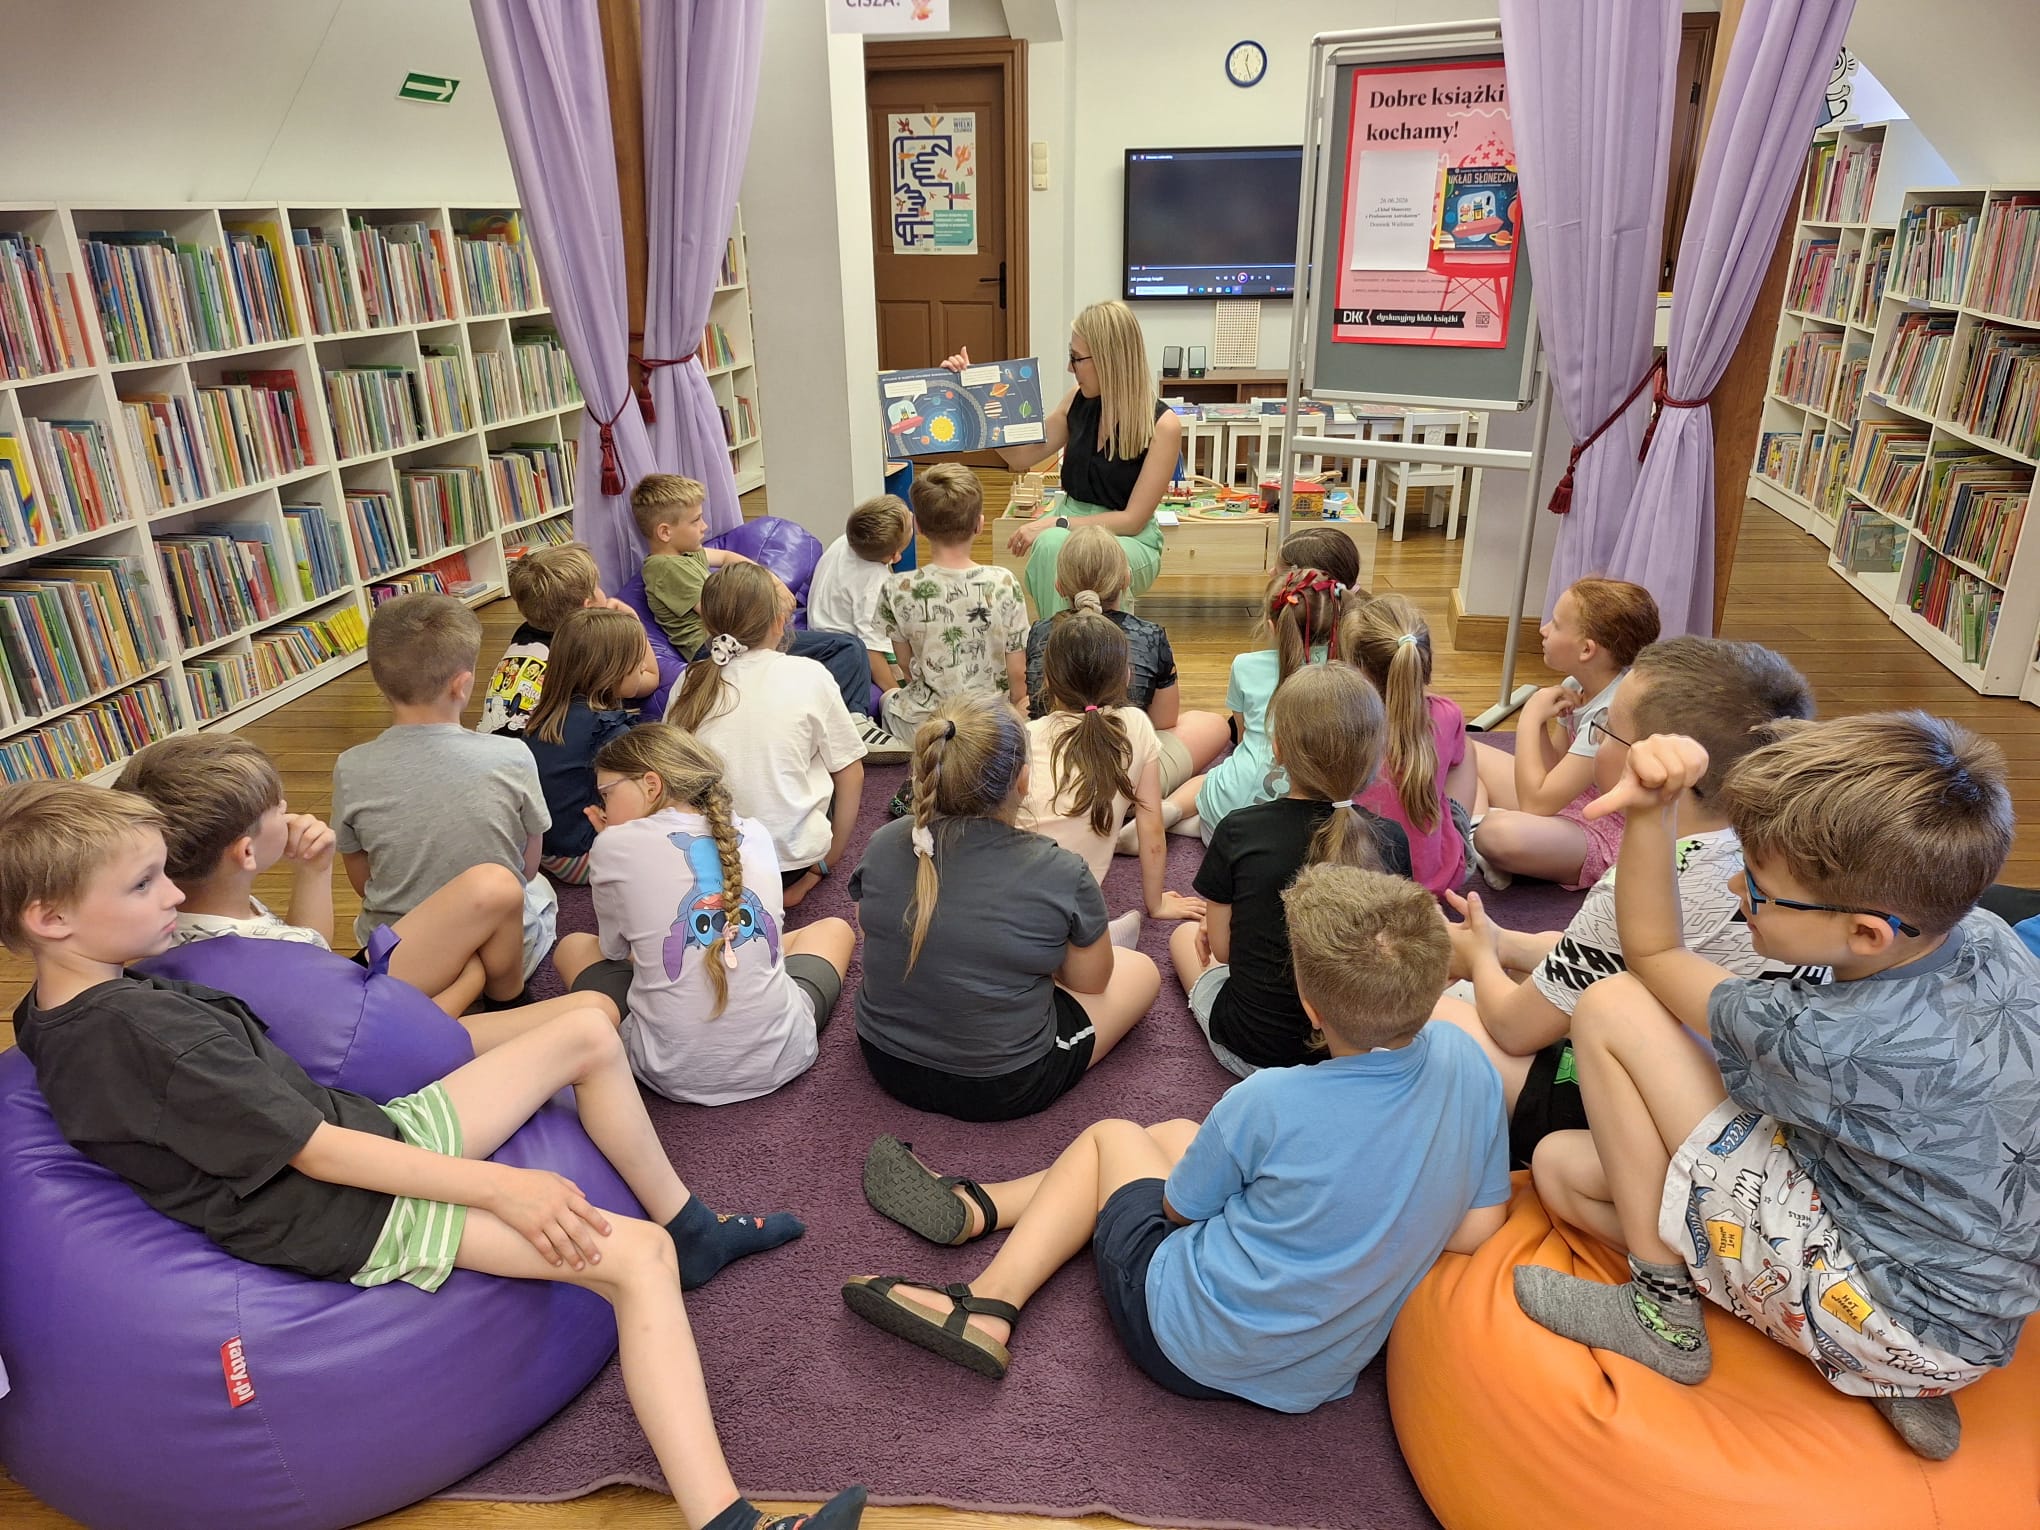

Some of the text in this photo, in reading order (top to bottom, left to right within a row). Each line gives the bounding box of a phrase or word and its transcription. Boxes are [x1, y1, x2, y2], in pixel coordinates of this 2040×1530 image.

[1370, 84, 1505, 109] Dobre książki
[1366, 121, 1459, 144] kochamy!
[1448, 172, 1517, 184] UKŁAD SŁONECZNY
[1376, 313, 1458, 324] dyskusyjny klub książki
